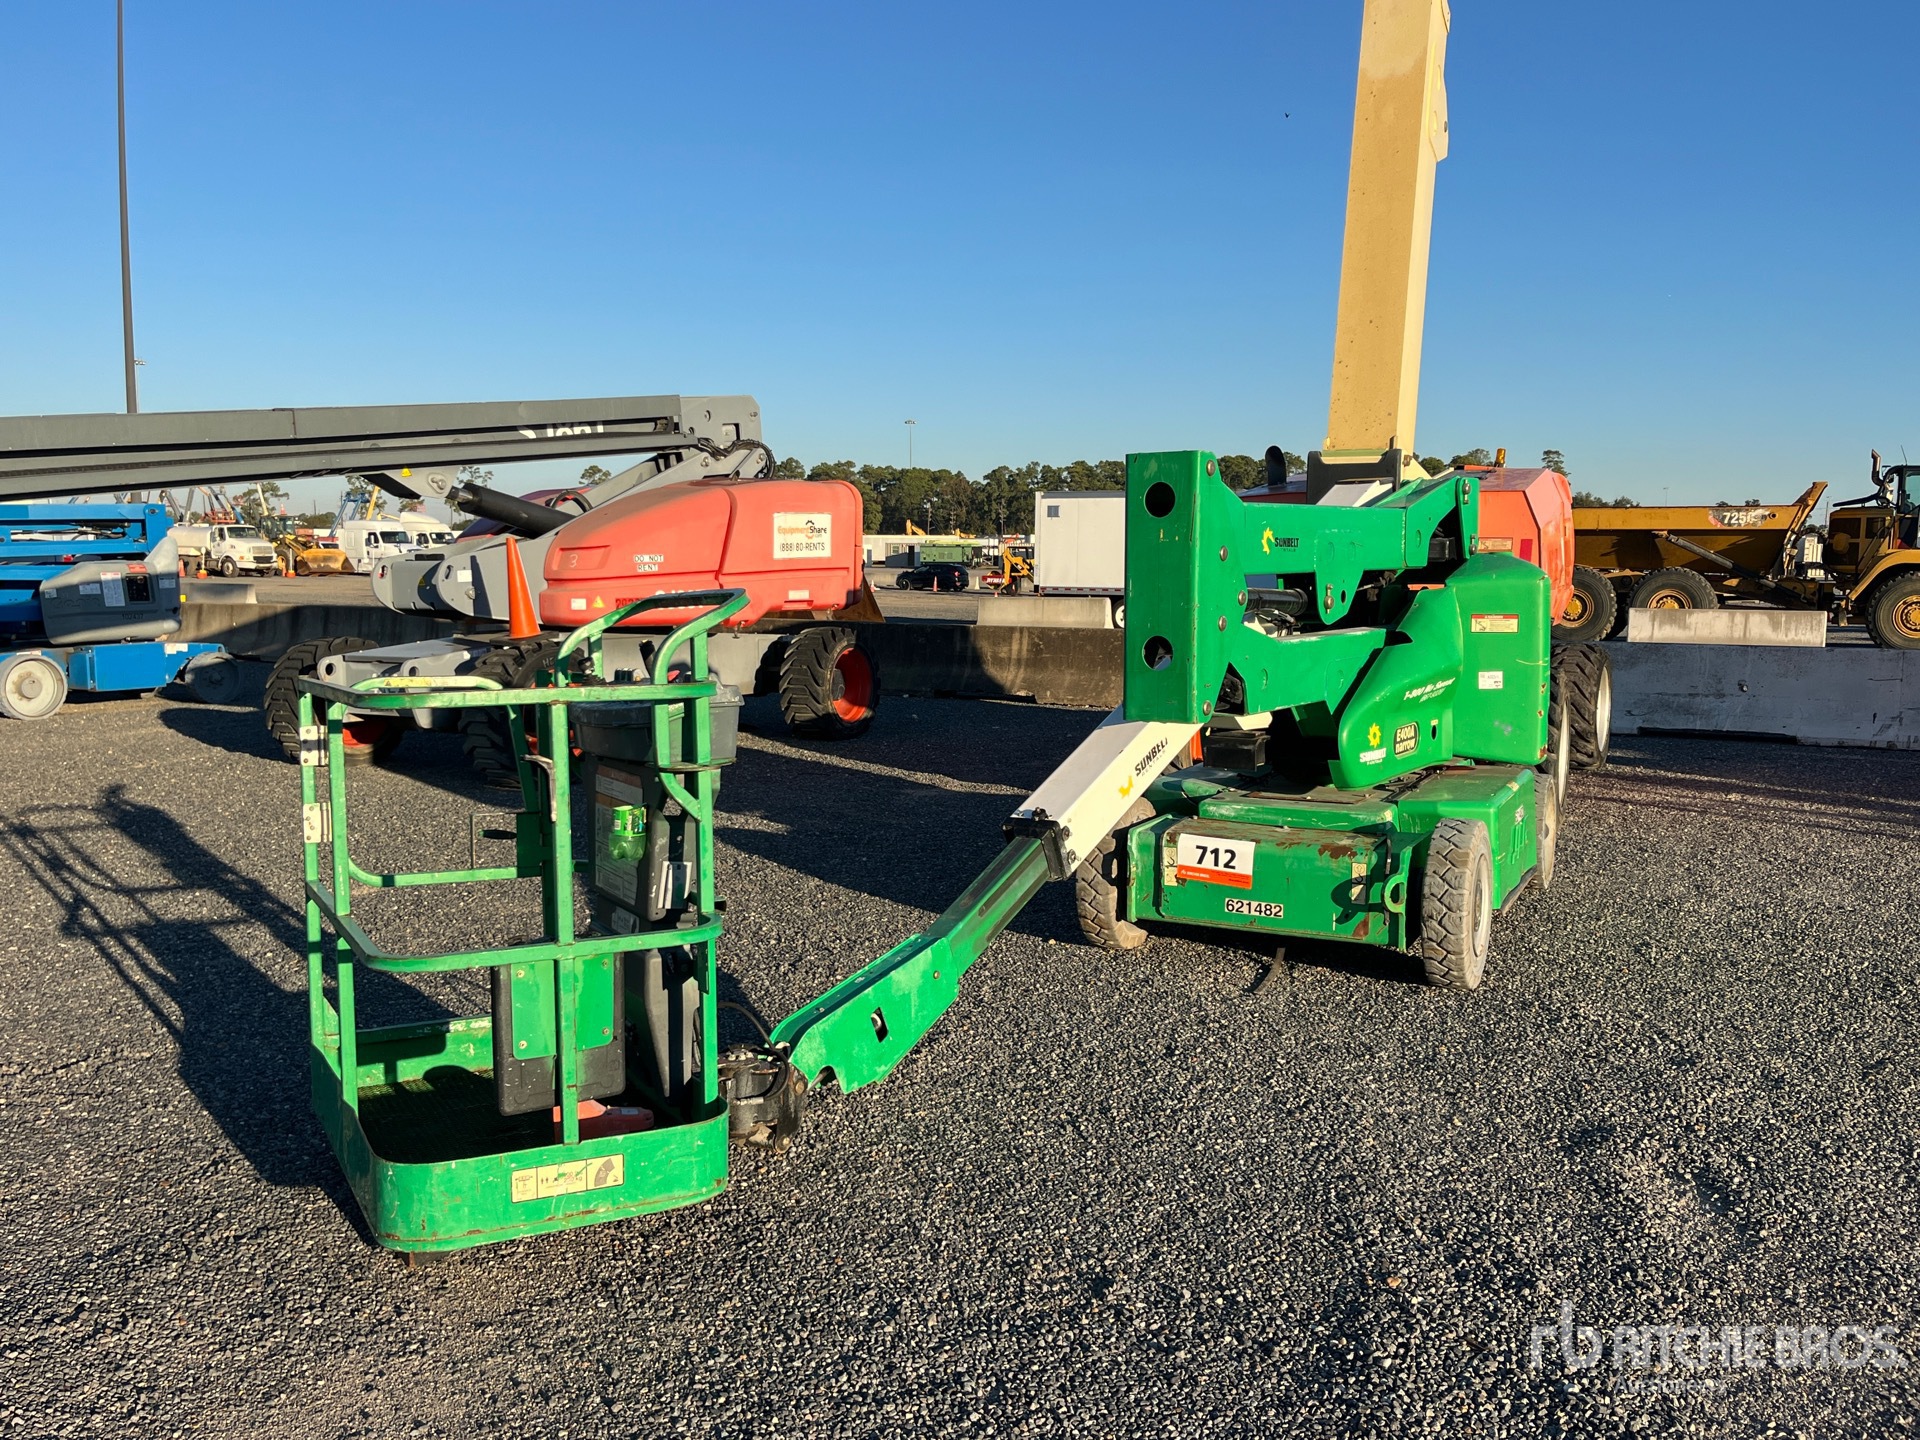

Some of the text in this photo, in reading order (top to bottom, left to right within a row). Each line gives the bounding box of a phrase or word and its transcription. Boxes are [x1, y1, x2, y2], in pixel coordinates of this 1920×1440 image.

[796, 542, 825, 551] 80-RENTS
[1274, 537, 1299, 547] SUNBELT
[1395, 738, 1415, 754] narrow
[1195, 845, 1236, 870] 712
[1226, 899, 1283, 918] 621482
